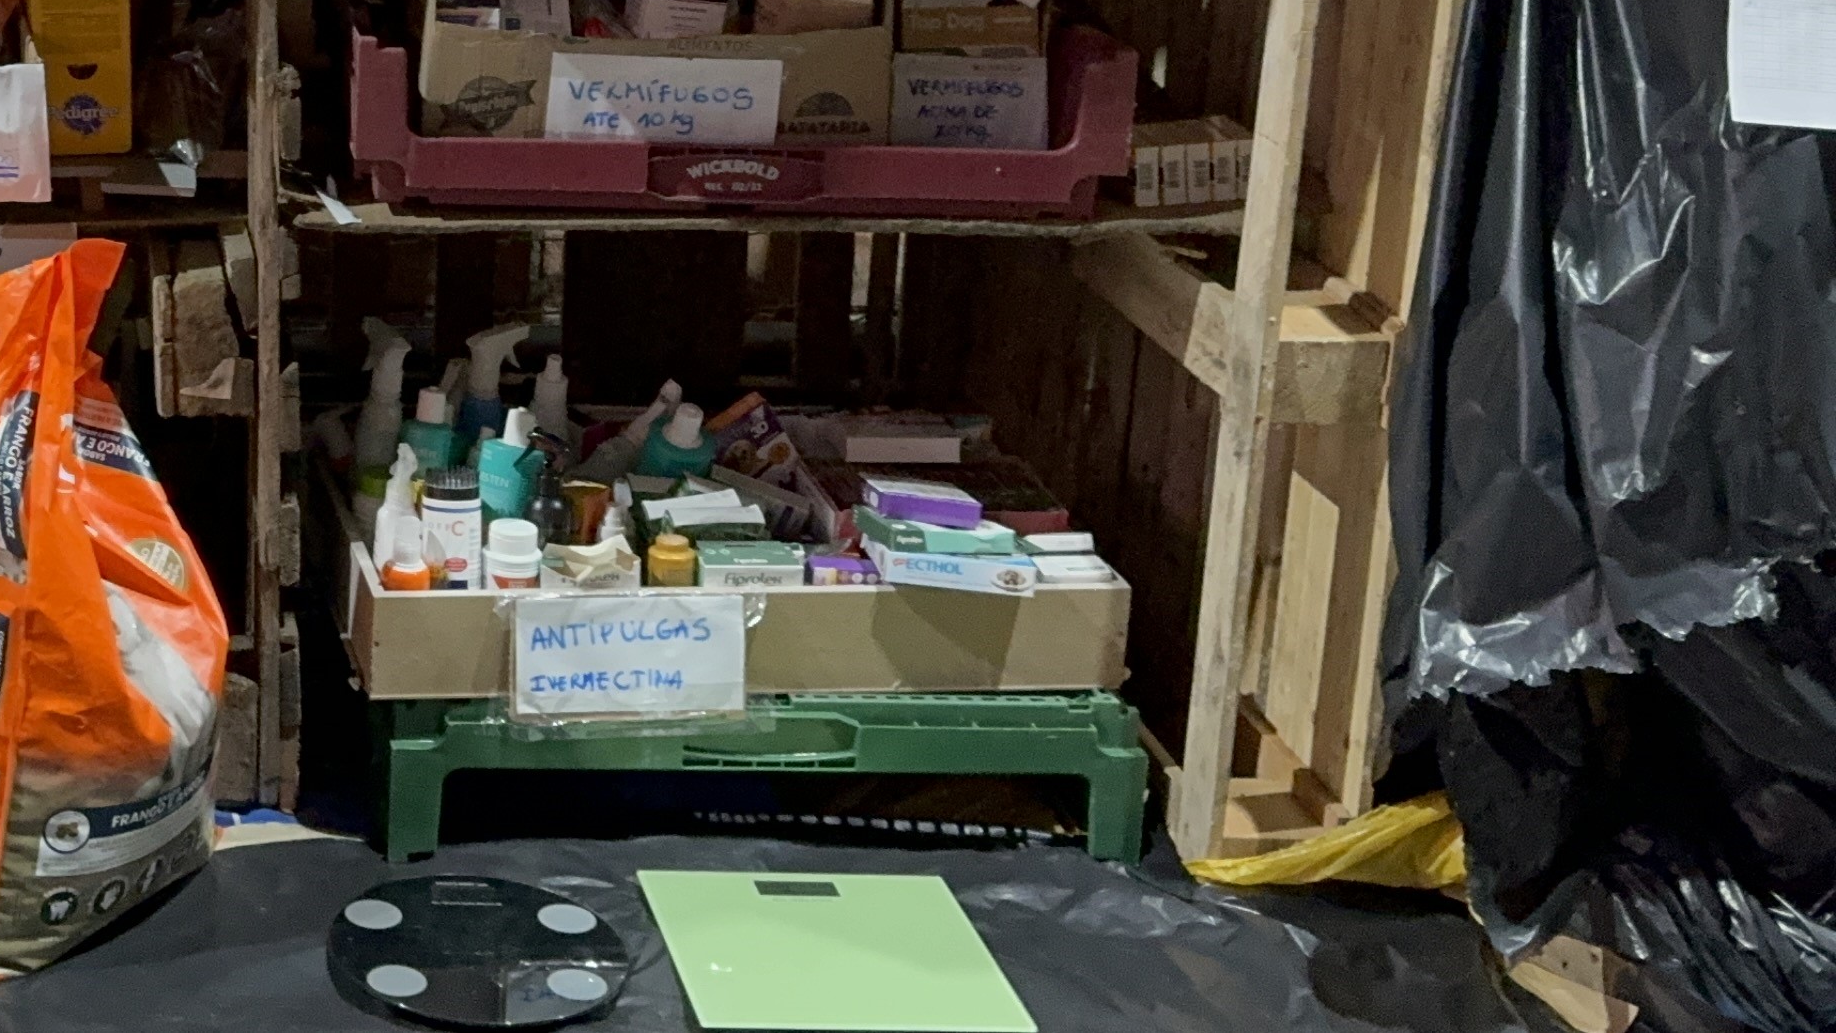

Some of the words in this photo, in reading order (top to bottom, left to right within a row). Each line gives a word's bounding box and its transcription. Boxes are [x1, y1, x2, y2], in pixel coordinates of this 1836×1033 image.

[568, 79, 754, 111] VERMÍFUGOS
[637, 112, 664, 128] 10
[685, 158, 781, 181] WICKBOLD
[4, 405, 35, 472] FRANGO
[96, 439, 151, 468] FRANGO
[0, 479, 17, 540] ARROZ
[530, 668, 684, 693] IVERMECTINA
